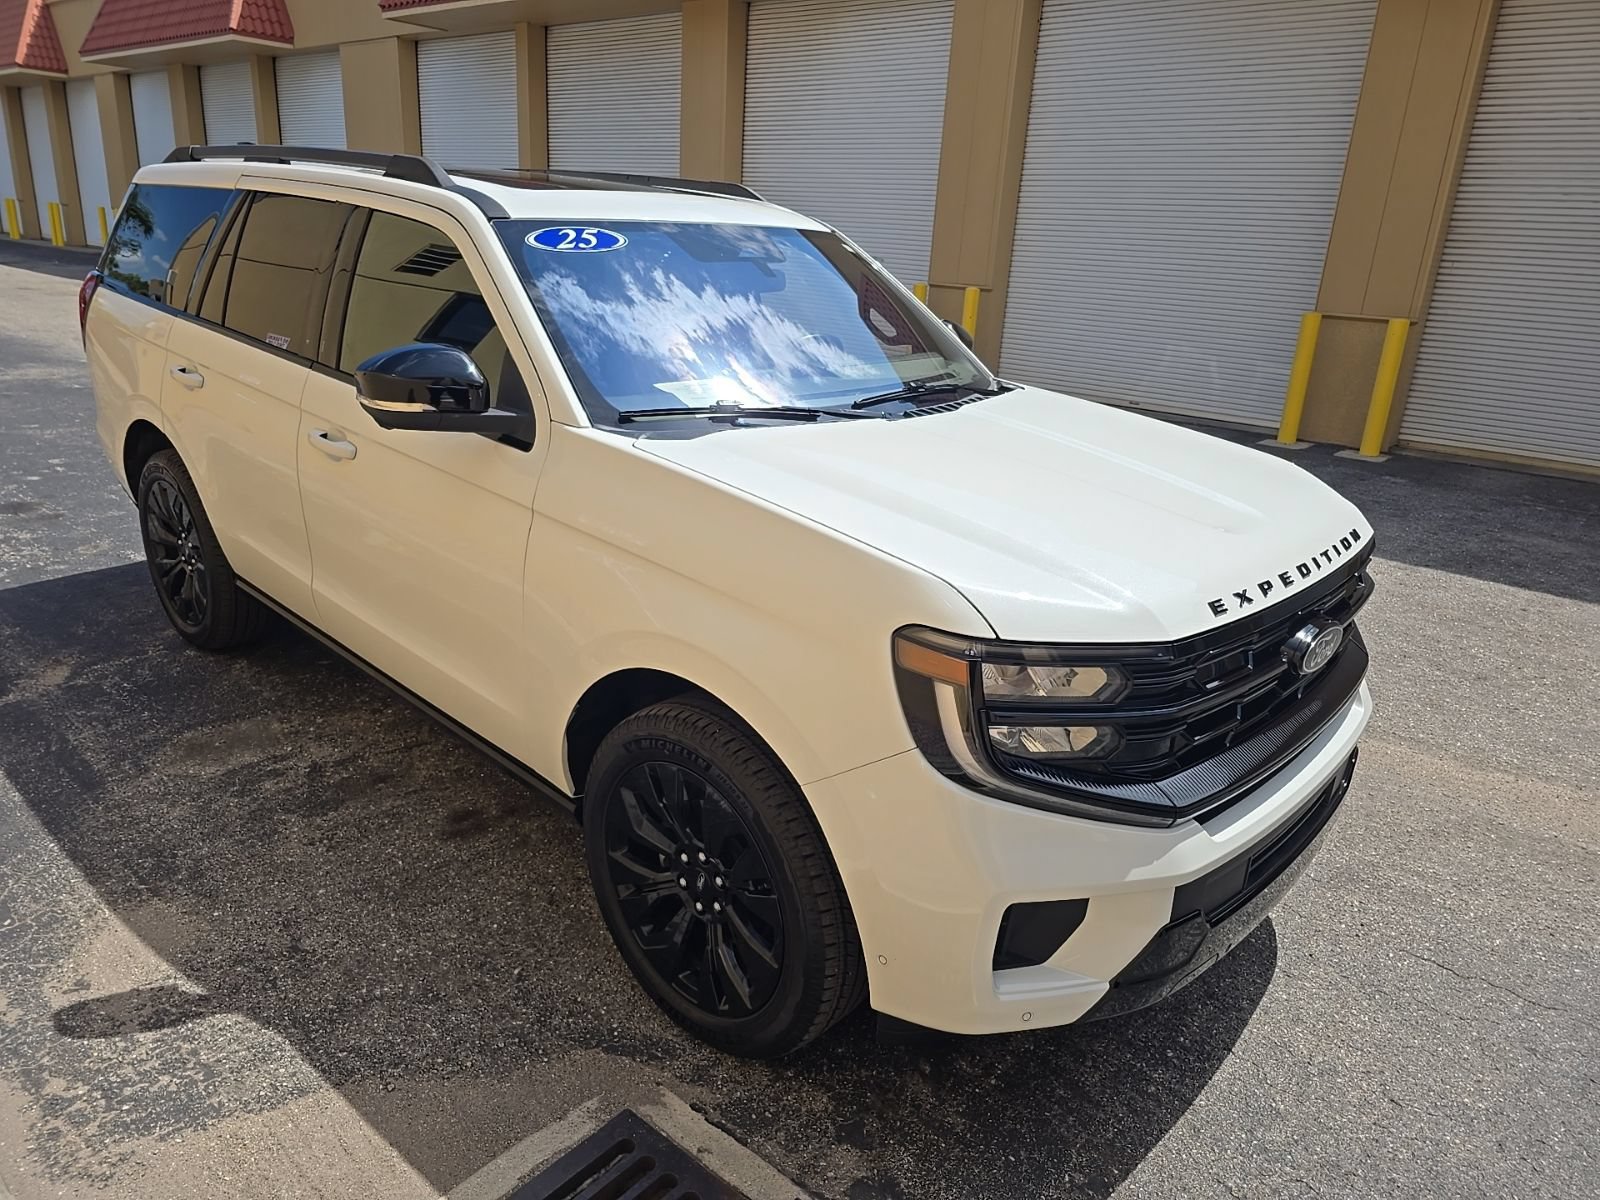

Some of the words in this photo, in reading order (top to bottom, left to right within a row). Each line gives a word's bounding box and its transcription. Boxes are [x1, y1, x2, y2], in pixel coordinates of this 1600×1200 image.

[556, 229, 599, 249] 25
[1207, 528, 1362, 618] EXPEDITION
[640, 739, 708, 769] MICHELIN
